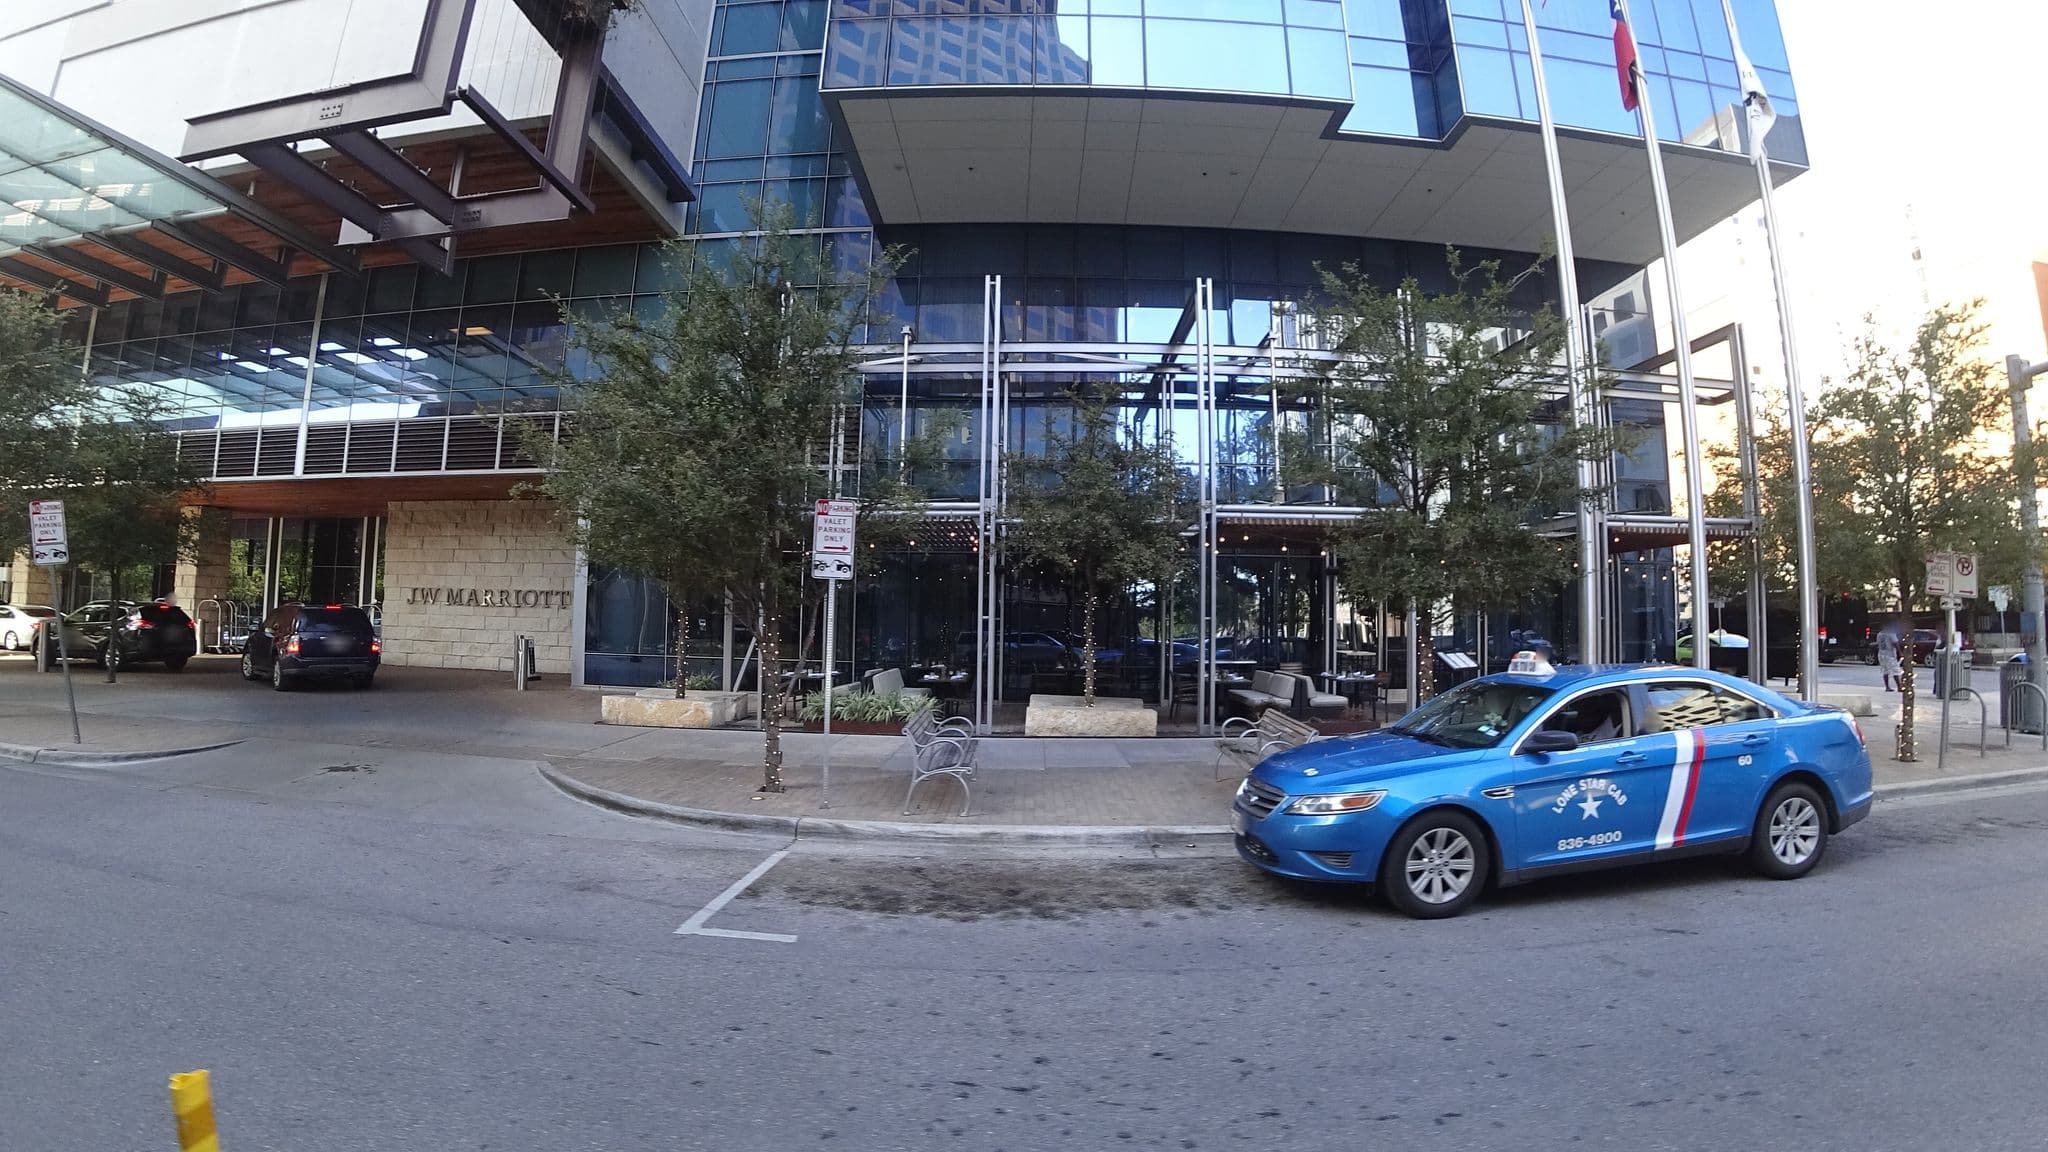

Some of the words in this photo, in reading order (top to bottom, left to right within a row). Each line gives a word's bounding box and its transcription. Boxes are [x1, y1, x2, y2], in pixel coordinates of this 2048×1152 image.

[817, 502, 828, 513] NO
[830, 504, 853, 512] PARKING
[407, 587, 440, 605] JW
[446, 587, 570, 609] MARRIOTT
[1738, 754, 1752, 766] 60
[1552, 784, 1579, 814] LONE
[1579, 777, 1606, 791] STAR
[1607, 784, 1628, 806] CAB
[1558, 830, 1622, 851] 836-4900
